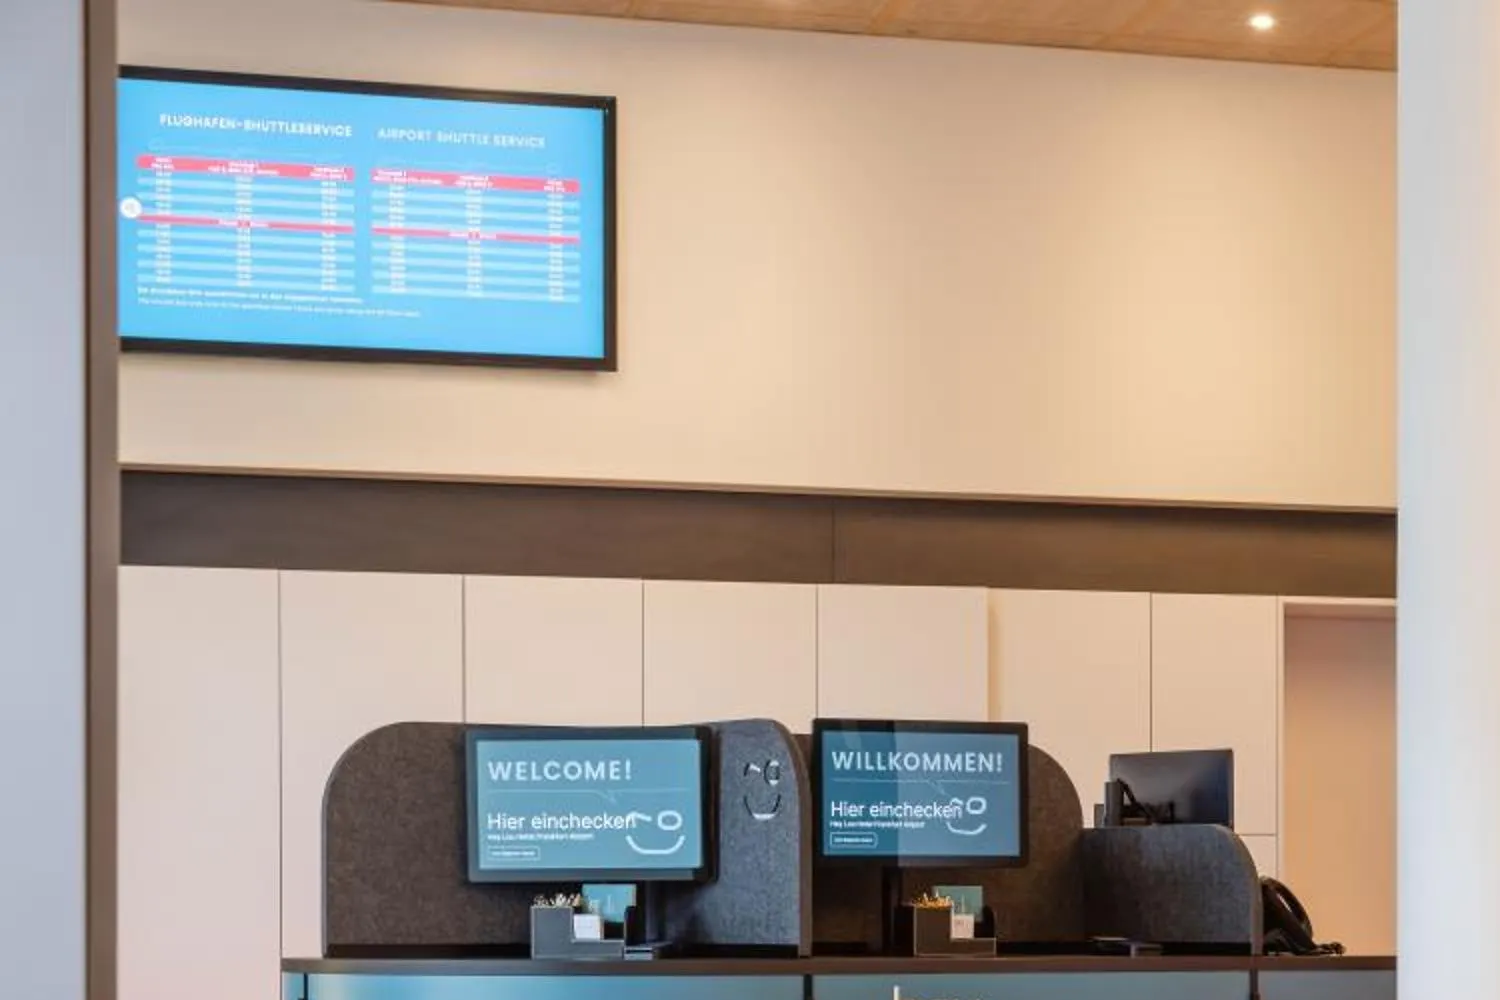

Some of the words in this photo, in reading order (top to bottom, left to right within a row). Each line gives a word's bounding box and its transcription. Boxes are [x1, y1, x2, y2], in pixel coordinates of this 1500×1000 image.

[377, 128, 431, 143] AIRPORT
[437, 131, 490, 147] SHUTTLE
[493, 134, 546, 149] SERVICE
[487, 760, 632, 781] WELCOME!
[831, 751, 1003, 773] WILLKOMMEN!
[487, 812, 526, 830] Hier
[531, 811, 637, 830] einchecken
[830, 801, 864, 818] Hier
[868, 801, 963, 820] einchecken
